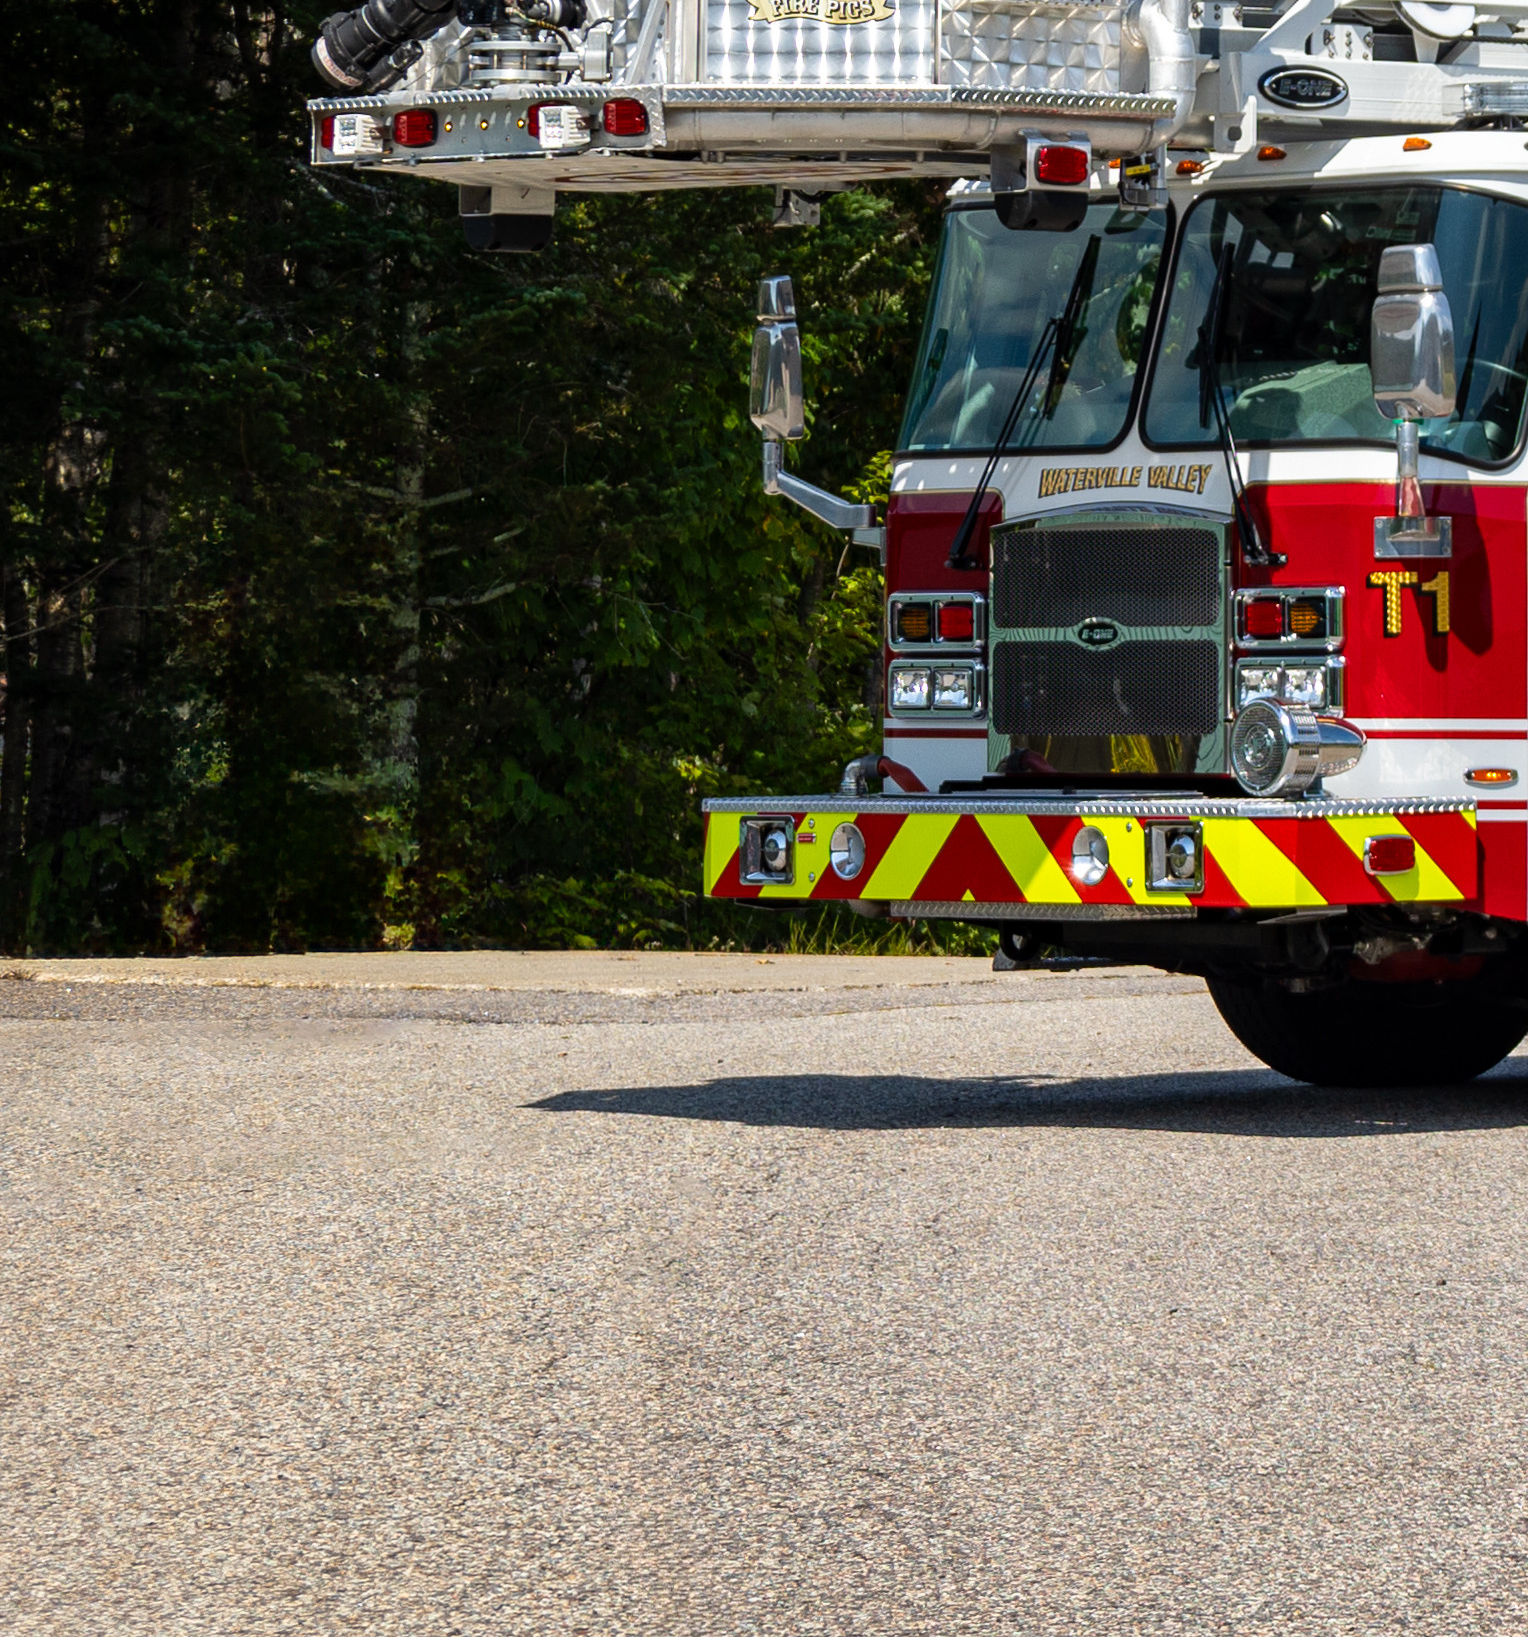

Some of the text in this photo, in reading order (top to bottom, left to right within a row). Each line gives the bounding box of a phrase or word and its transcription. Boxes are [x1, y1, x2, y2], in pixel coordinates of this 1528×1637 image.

[1279, 78, 1334, 97] E-ONE
[1038, 464, 1213, 499] WATERVILLE VALLEY
